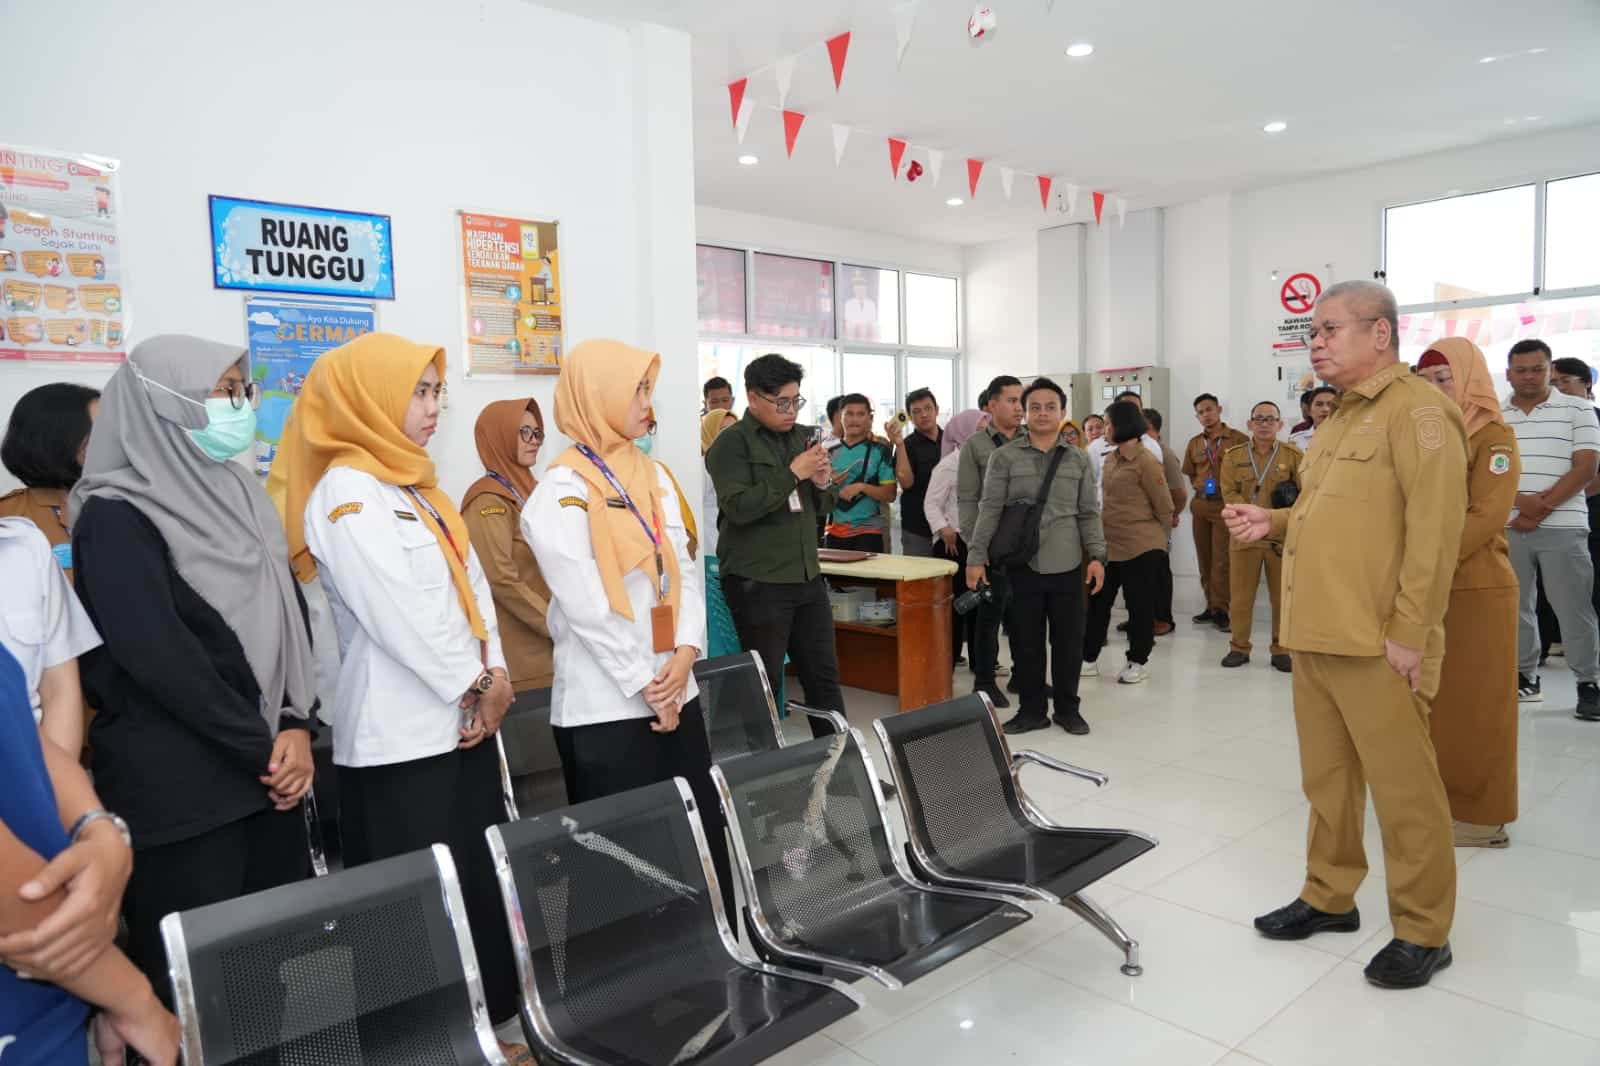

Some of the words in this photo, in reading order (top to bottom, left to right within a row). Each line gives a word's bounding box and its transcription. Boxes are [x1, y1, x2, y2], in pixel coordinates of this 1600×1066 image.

[261, 218, 349, 251] RUANG
[467, 239, 520, 255] HIPERTENSI
[246, 249, 365, 283] TUNGGU
